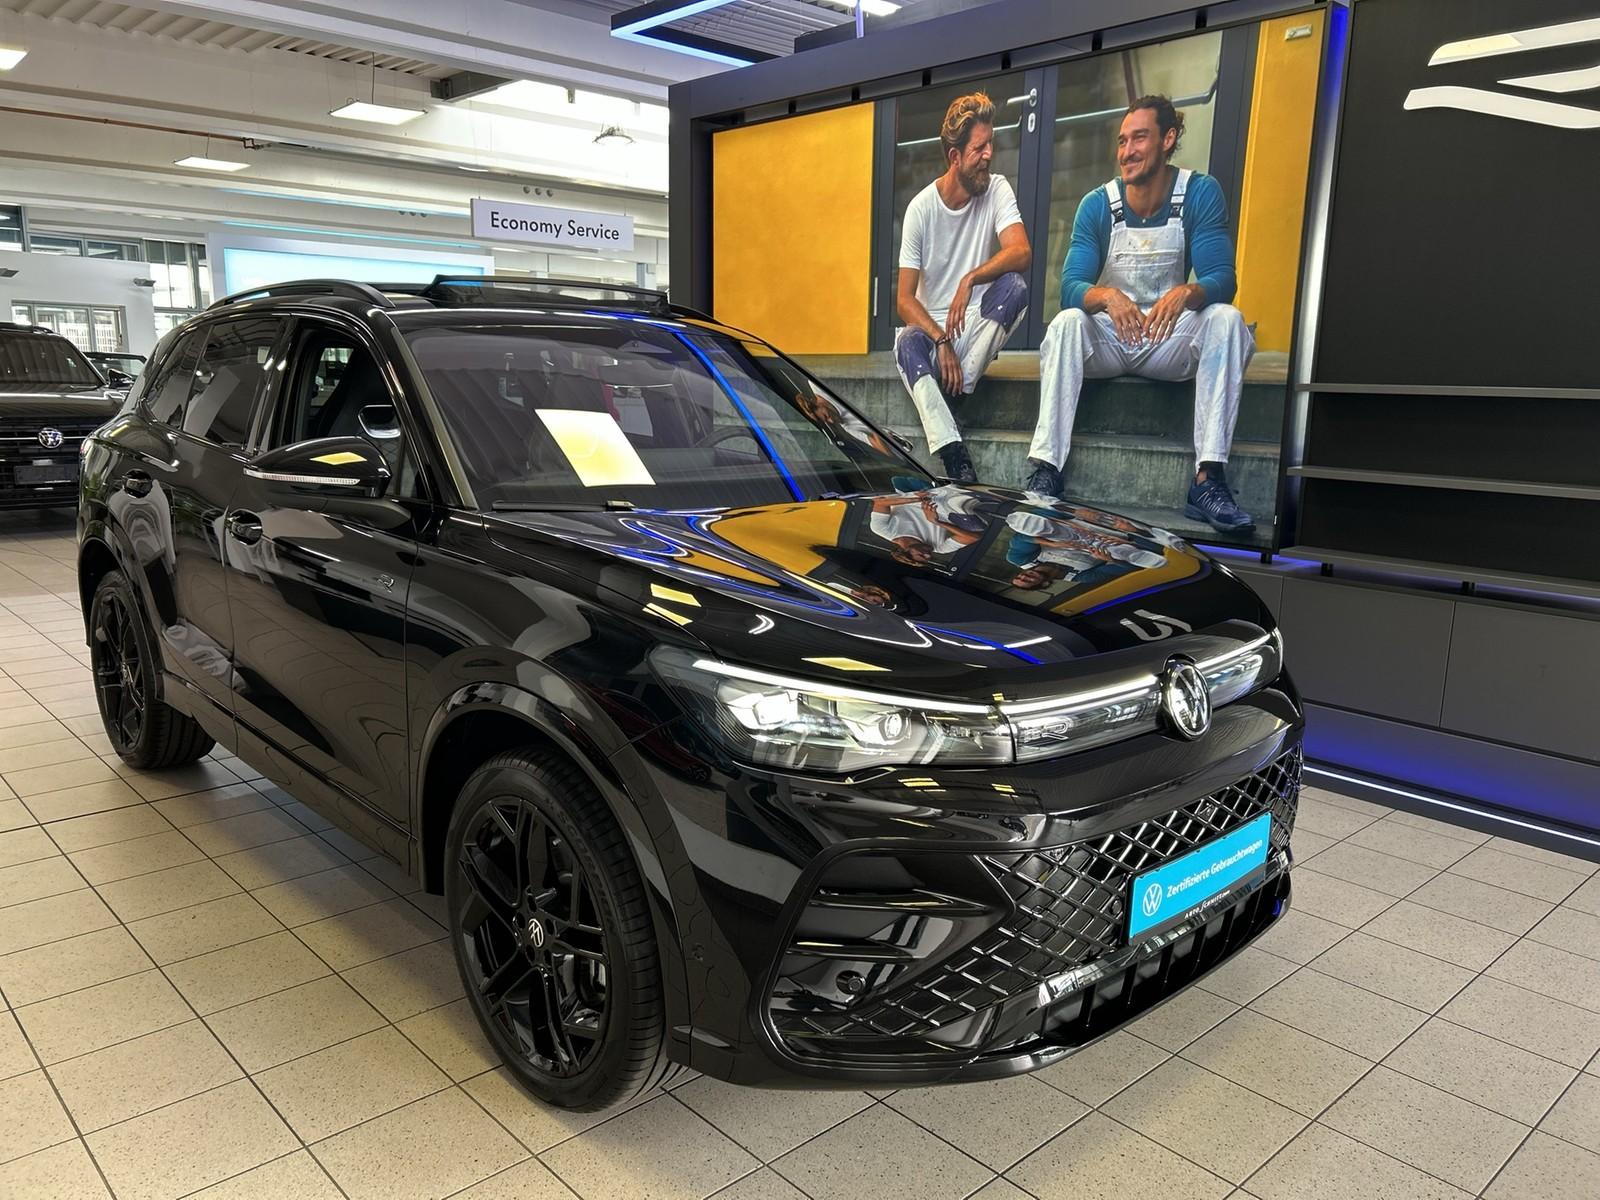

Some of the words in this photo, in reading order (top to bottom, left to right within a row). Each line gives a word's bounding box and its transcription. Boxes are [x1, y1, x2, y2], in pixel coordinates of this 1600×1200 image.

[490, 211, 563, 238] Economy
[567, 219, 620, 240] Service
[1166, 868, 1211, 898] Zertifizierte
[1211, 840, 1263, 875] Gebrauchtwagen
